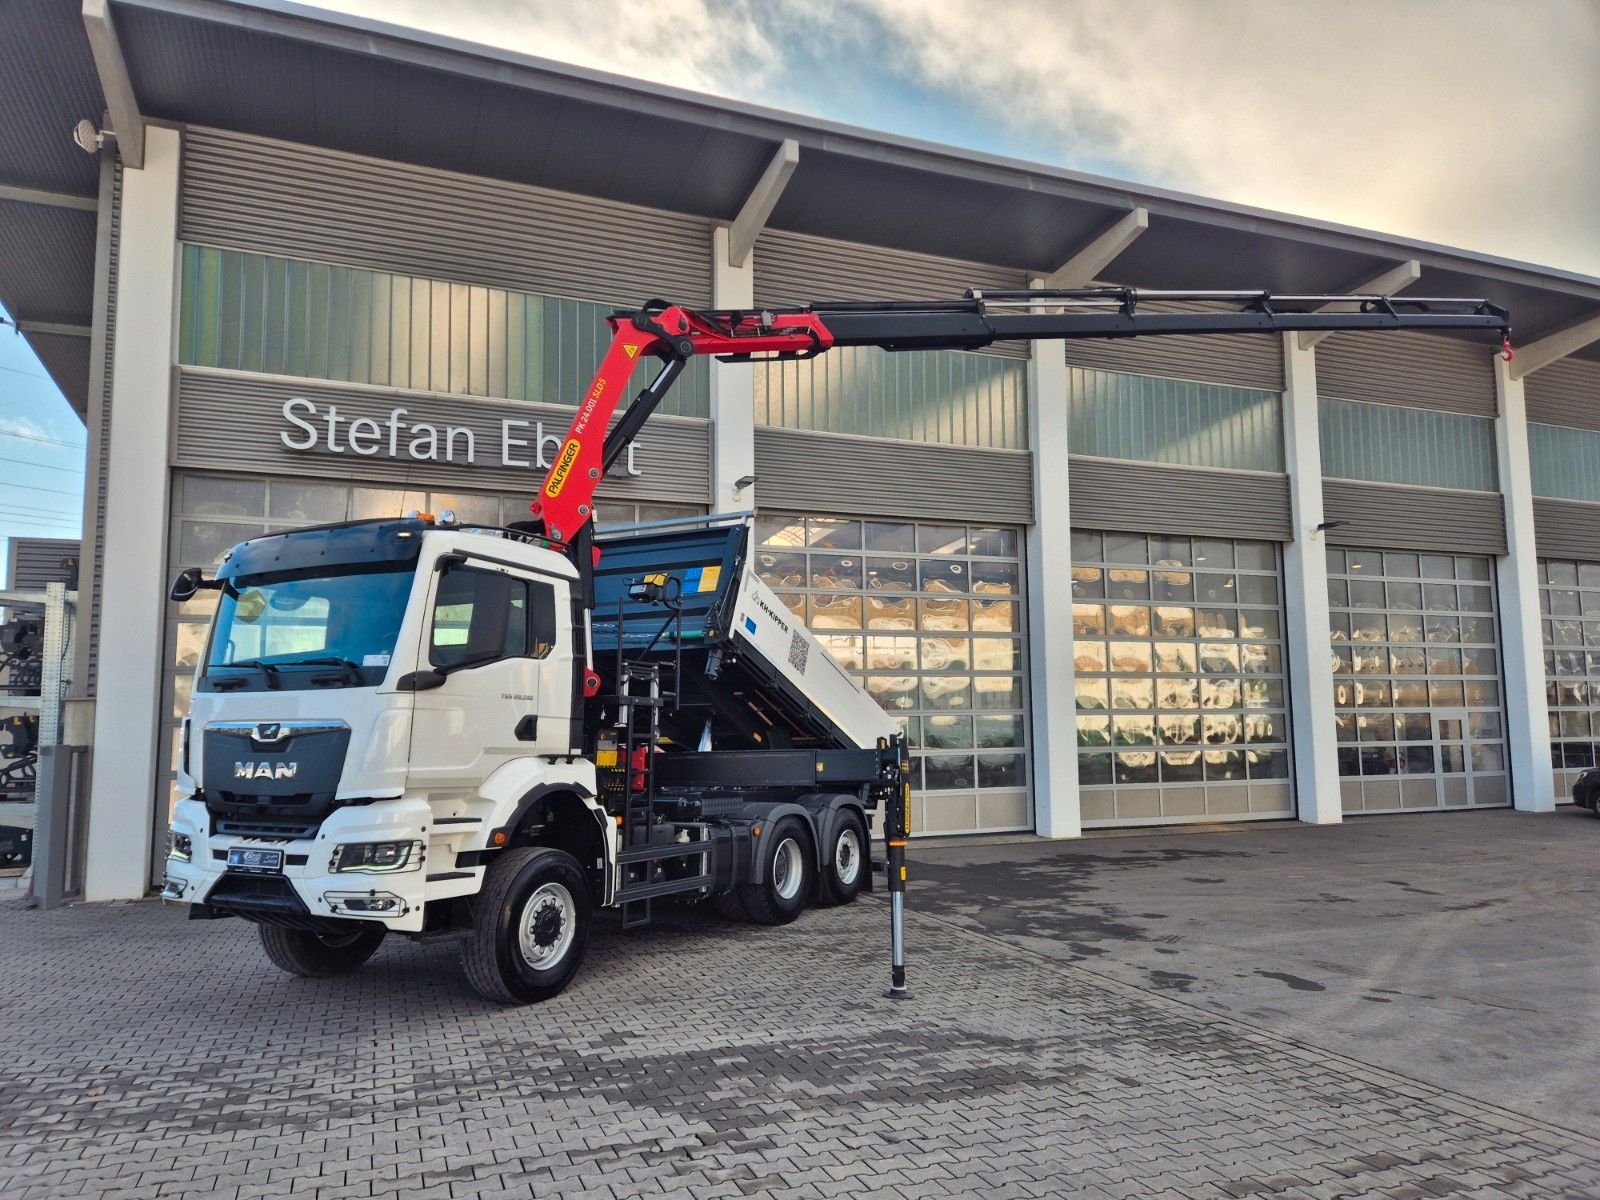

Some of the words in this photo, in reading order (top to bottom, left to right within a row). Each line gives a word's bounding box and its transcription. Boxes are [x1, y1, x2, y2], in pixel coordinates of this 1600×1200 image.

[280, 397, 475, 464] Stefan
[502, 418, 642, 476] Ebt
[575, 422, 586, 434] PK
[548, 442, 579, 494] PALFINGER
[760, 600, 789, 634] KH-KIPPER
[234, 761, 298, 780] MAN
